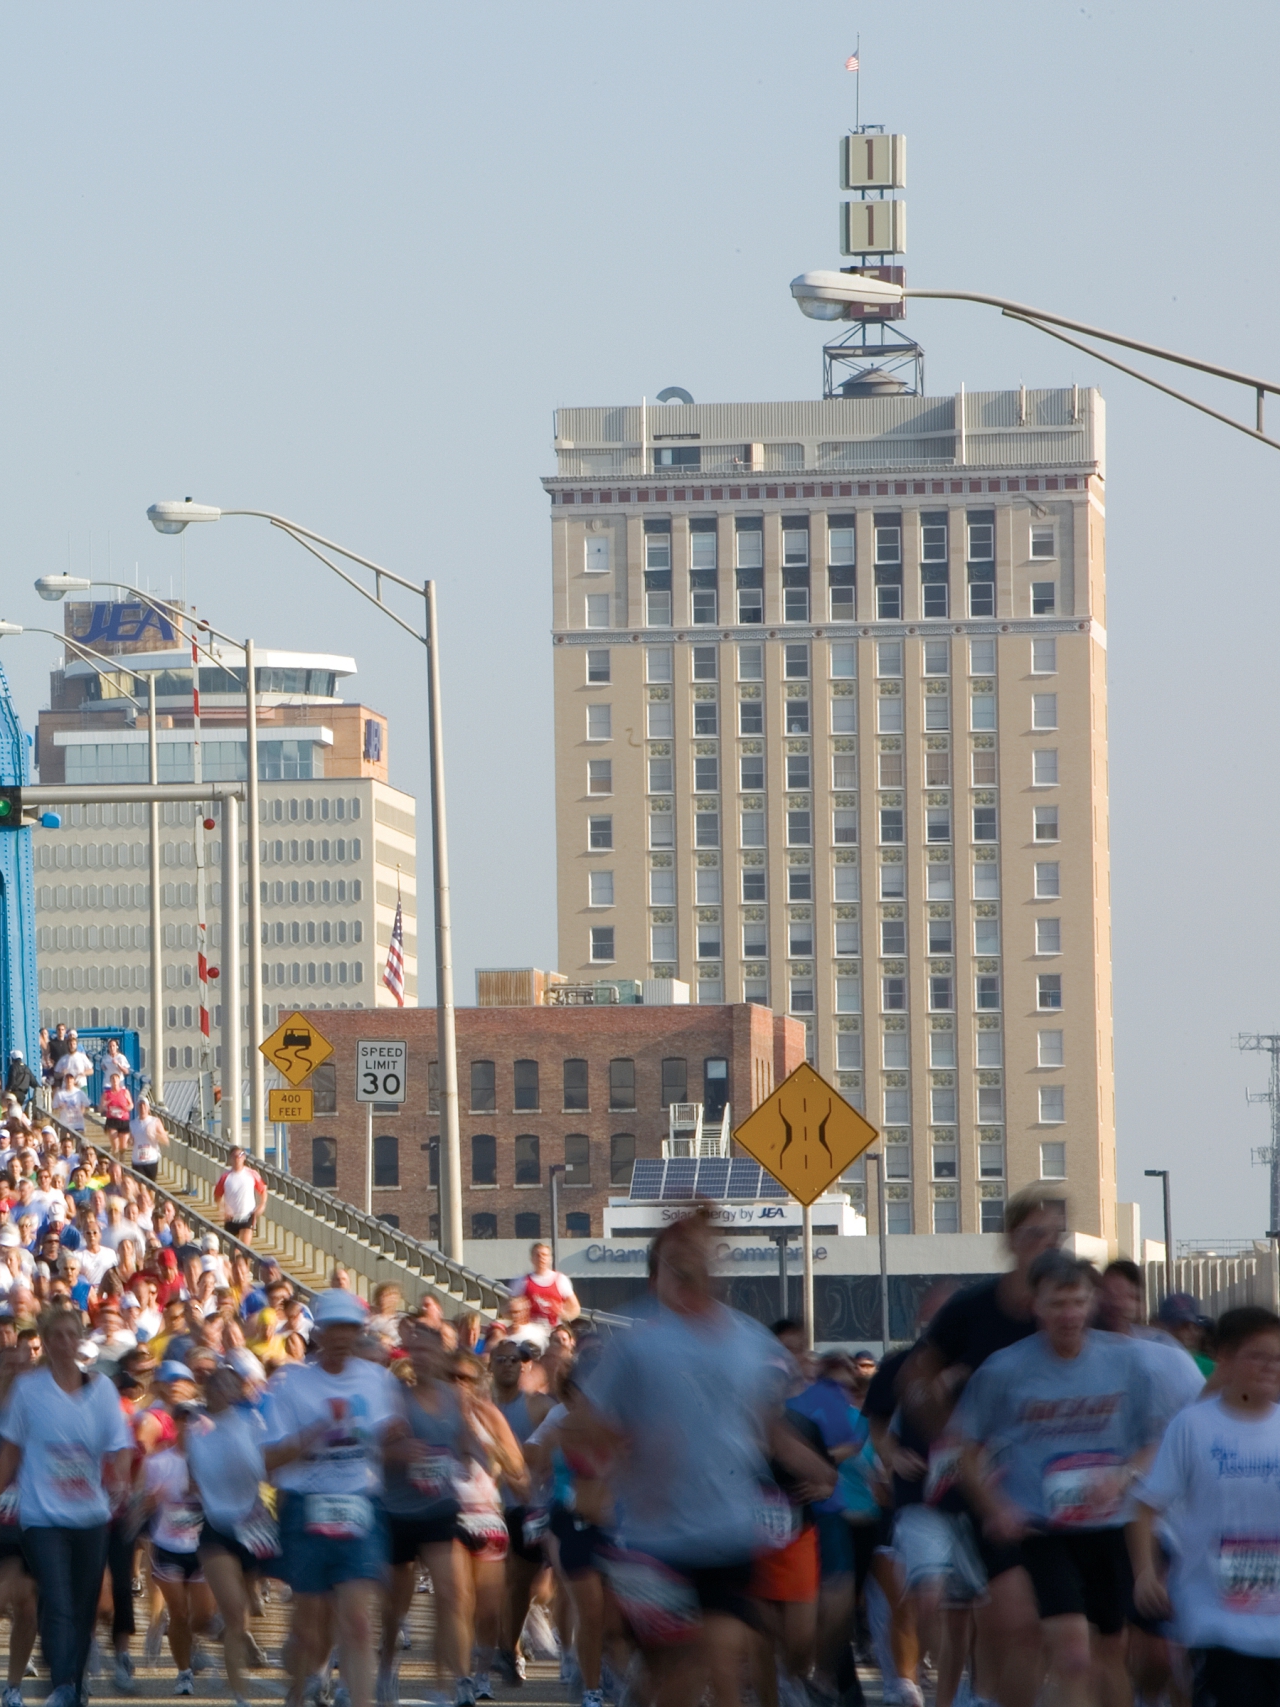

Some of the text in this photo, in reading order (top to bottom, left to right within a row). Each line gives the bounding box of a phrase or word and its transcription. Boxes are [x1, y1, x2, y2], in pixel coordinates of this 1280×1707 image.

[72, 602, 175, 644] JEA
[361, 1047, 403, 1057] SPEED
[365, 1060, 398, 1070] LIMIT
[362, 1073, 400, 1095] 30
[281, 1094, 301, 1103] 400
[279, 1107, 302, 1116] FEET
[662, 1208, 785, 1222] Solar nergy by JEA
[716, 1243, 828, 1263] Commere
